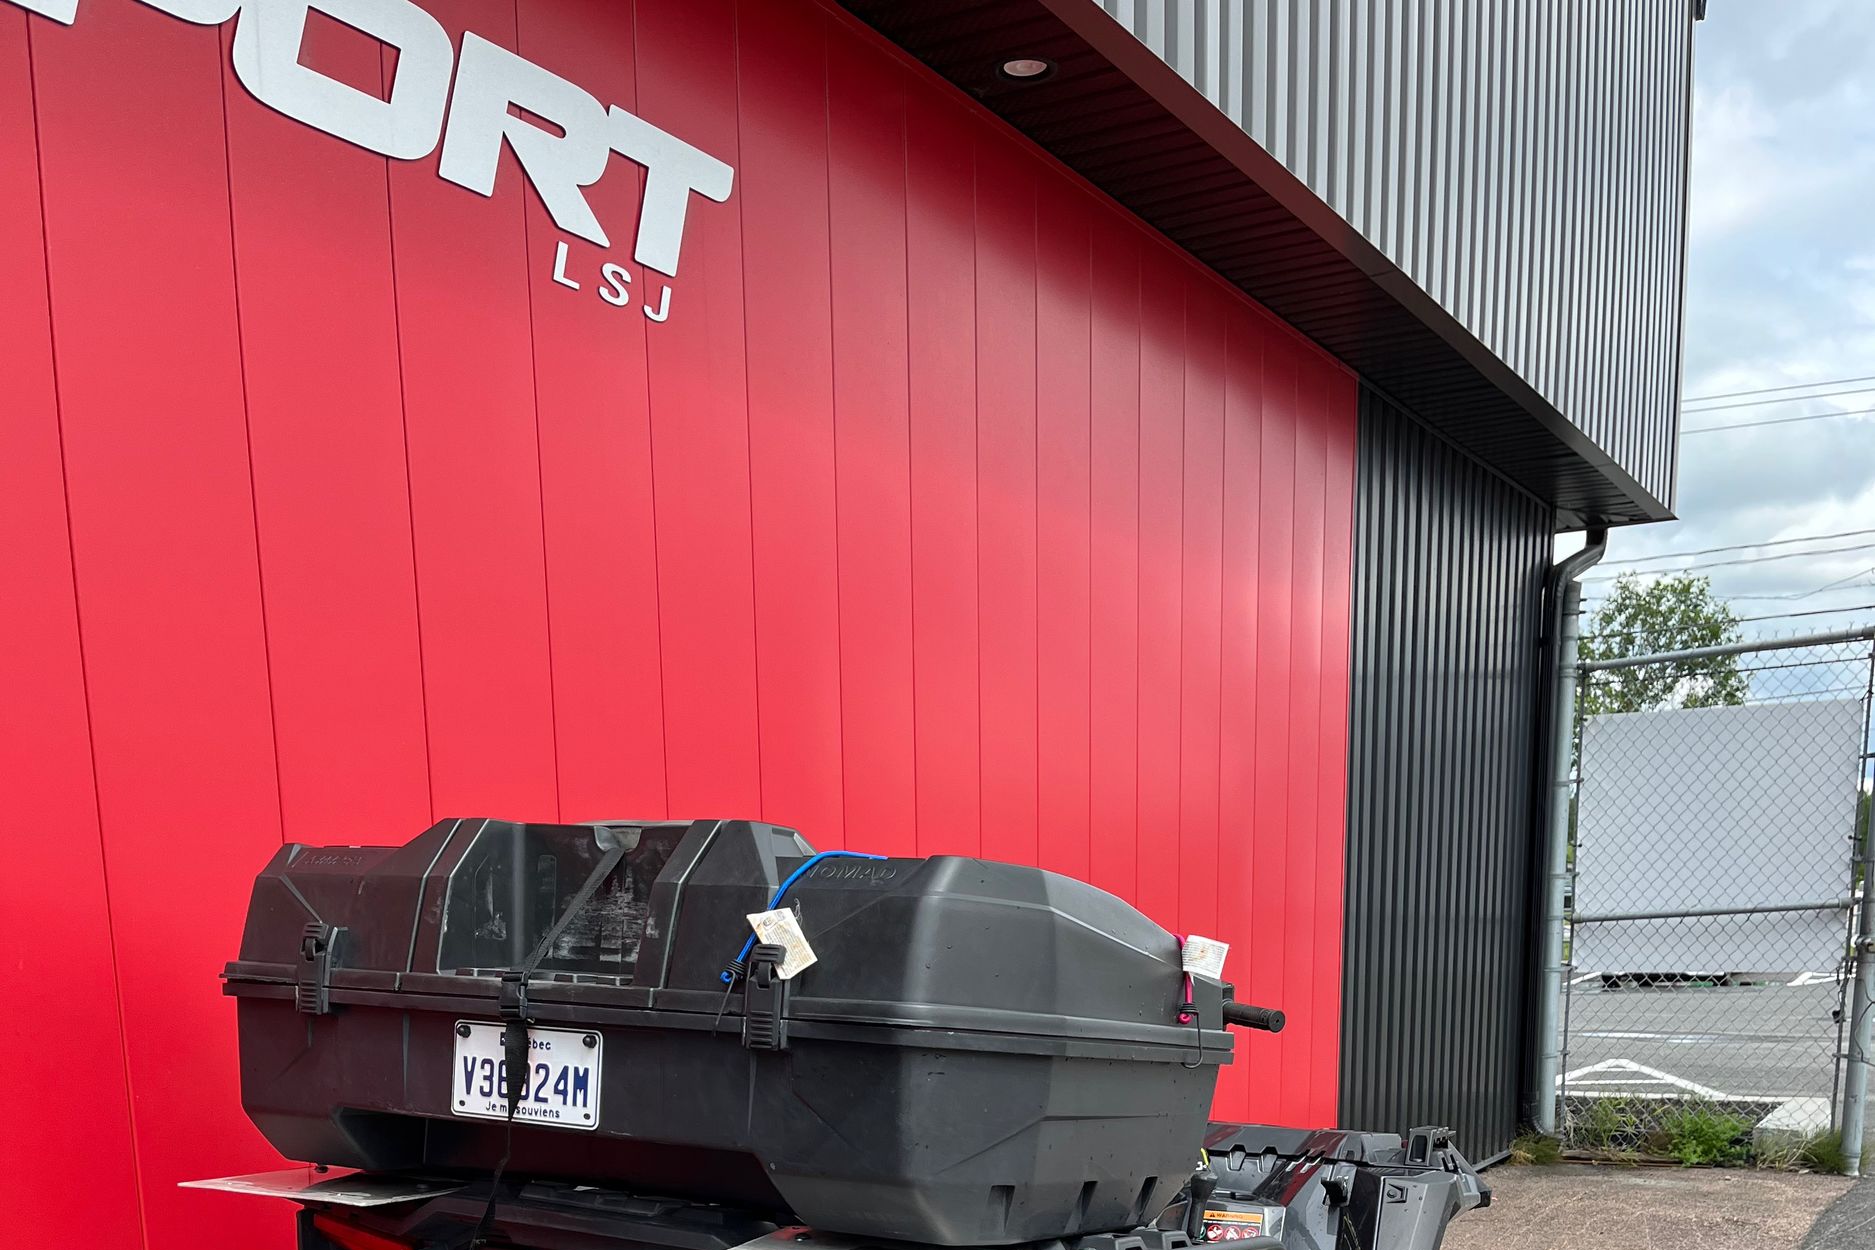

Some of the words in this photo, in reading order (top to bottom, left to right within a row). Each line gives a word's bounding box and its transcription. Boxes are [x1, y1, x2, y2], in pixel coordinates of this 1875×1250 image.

[8, 0, 734, 277] ORT
[486, 1101, 497, 1112] Je
[515, 1105, 560, 1119] souviens
